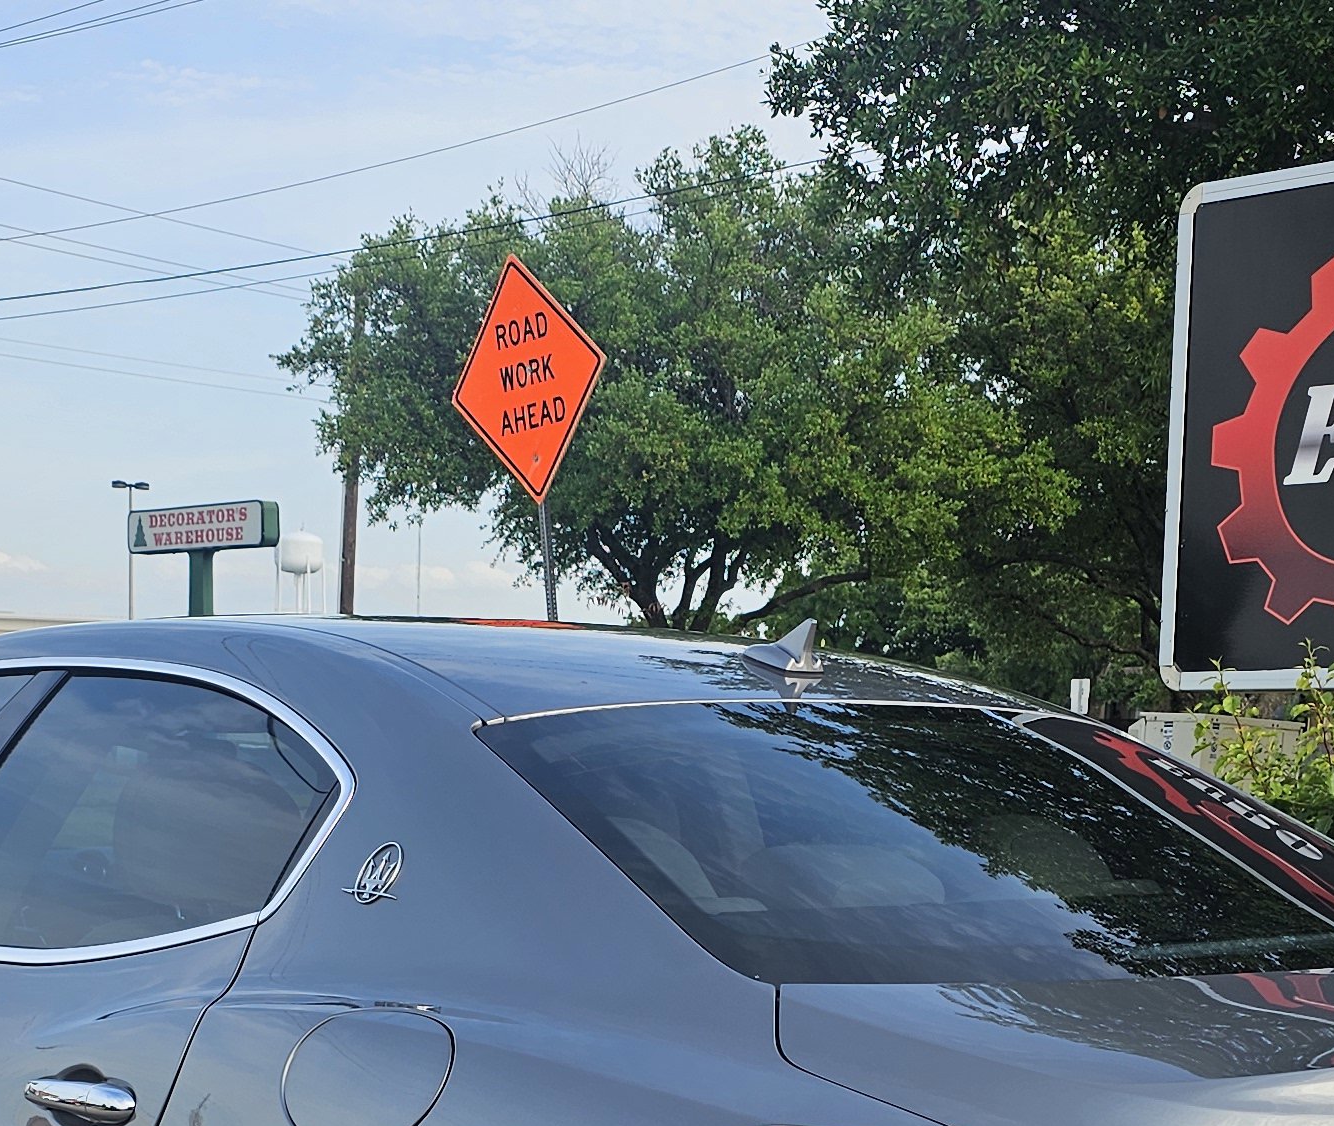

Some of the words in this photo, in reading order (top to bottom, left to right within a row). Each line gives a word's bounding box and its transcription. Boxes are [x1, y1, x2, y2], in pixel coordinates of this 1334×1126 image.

[495, 311, 548, 350] ROAD
[499, 353, 556, 392] WORK
[500, 395, 566, 436] AHEAD
[149, 507, 247, 528] DECORATOR'S
[153, 527, 243, 547] WAREHOUSE
